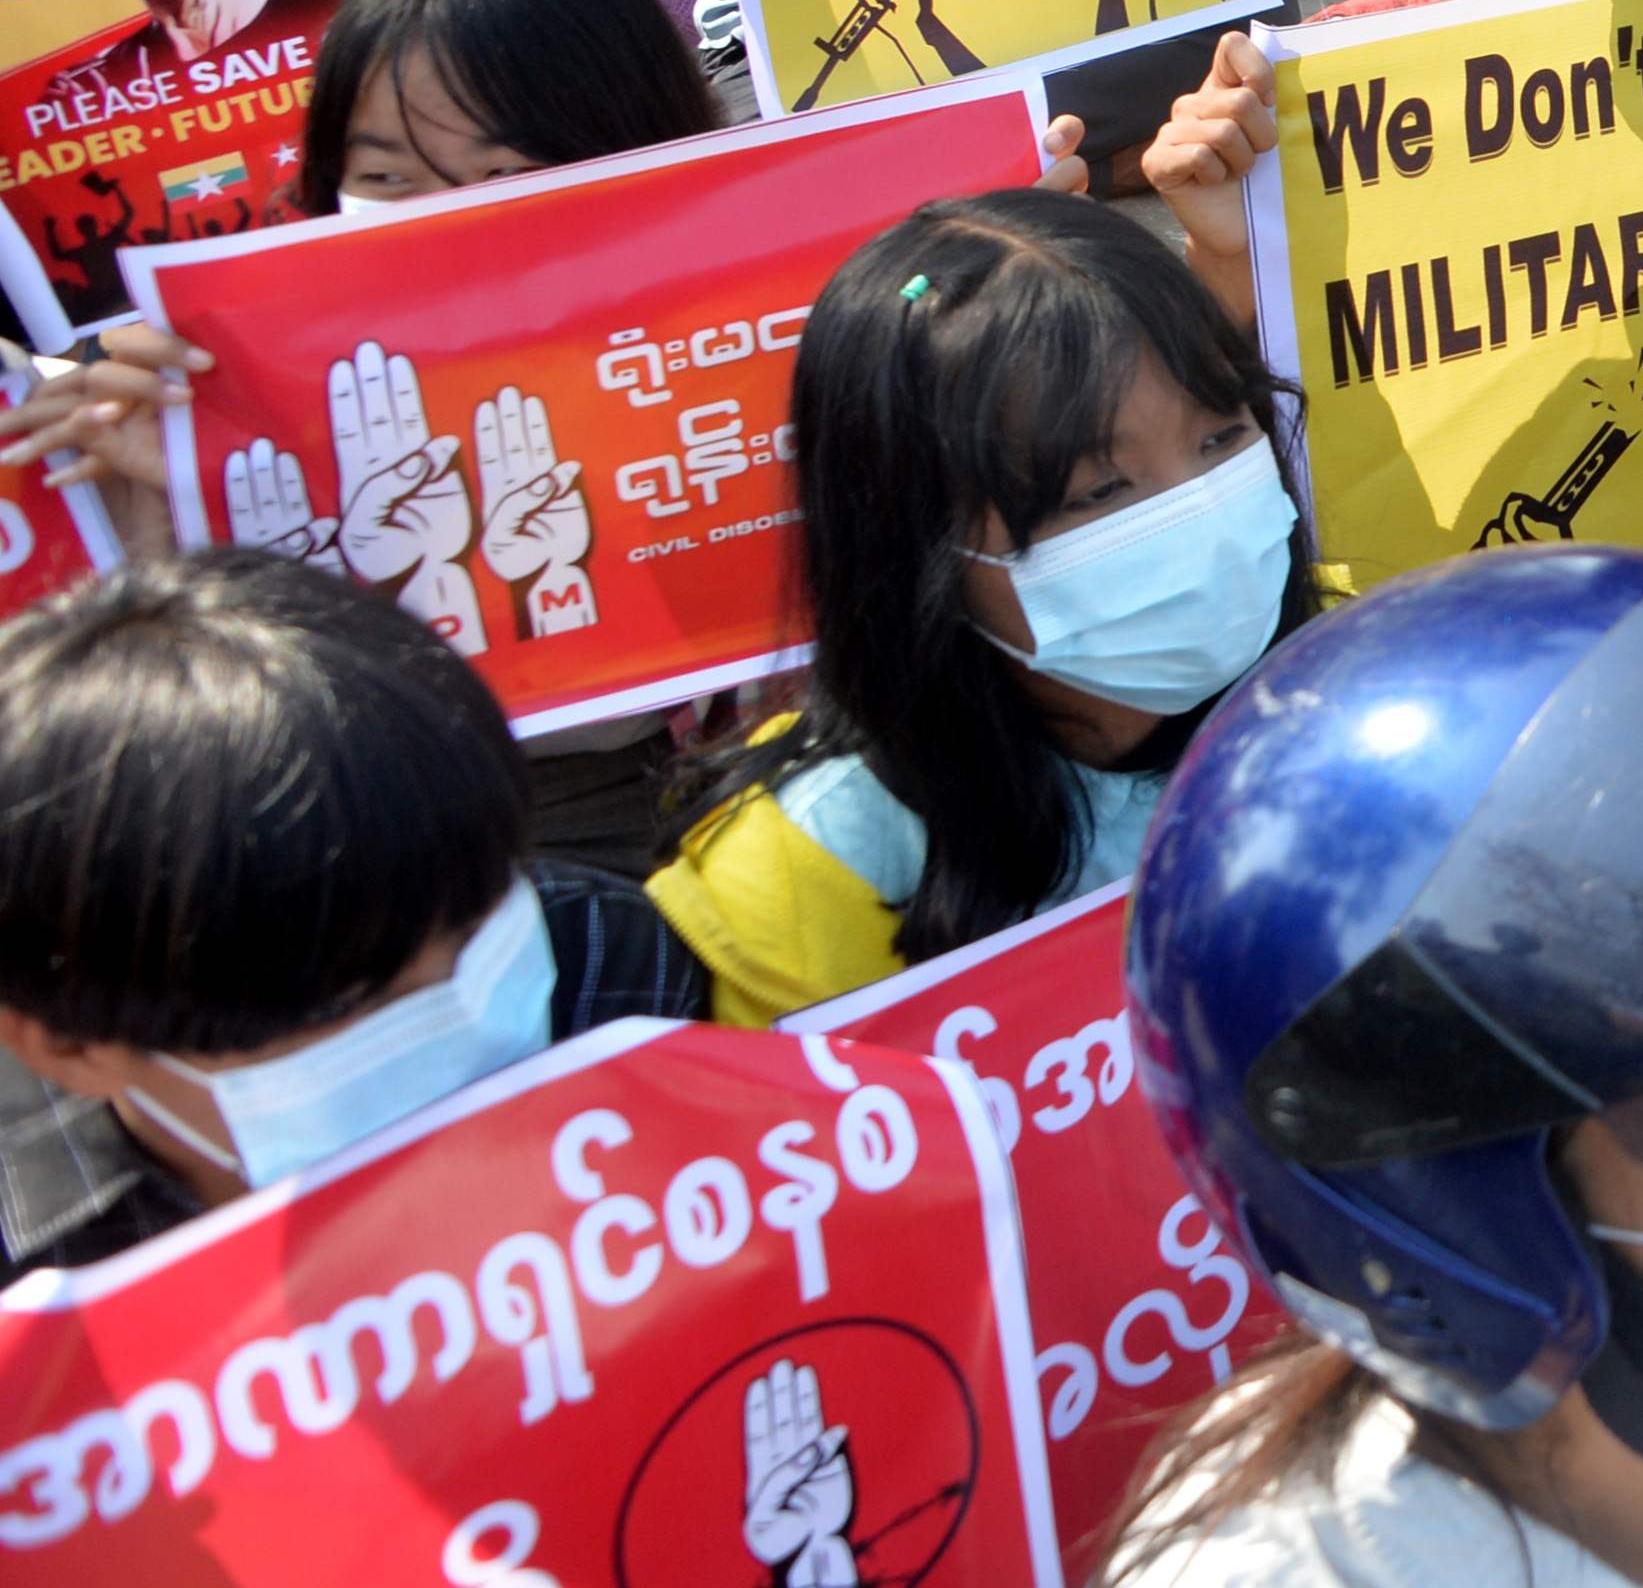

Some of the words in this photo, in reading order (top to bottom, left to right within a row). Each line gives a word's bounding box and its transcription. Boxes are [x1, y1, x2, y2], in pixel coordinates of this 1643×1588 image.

[0, 123, 148, 191] EADER
[170, 72, 314, 144] FUTUR
[25, 60, 184, 140] PLEASE
[192, 35, 314, 96] SAVE
[1307, 76, 1436, 197] We
[597, 305, 813, 409] ရုံးမတ
[628, 536, 699, 565] CIVIL
[708, 509, 806, 548] DISOBE
